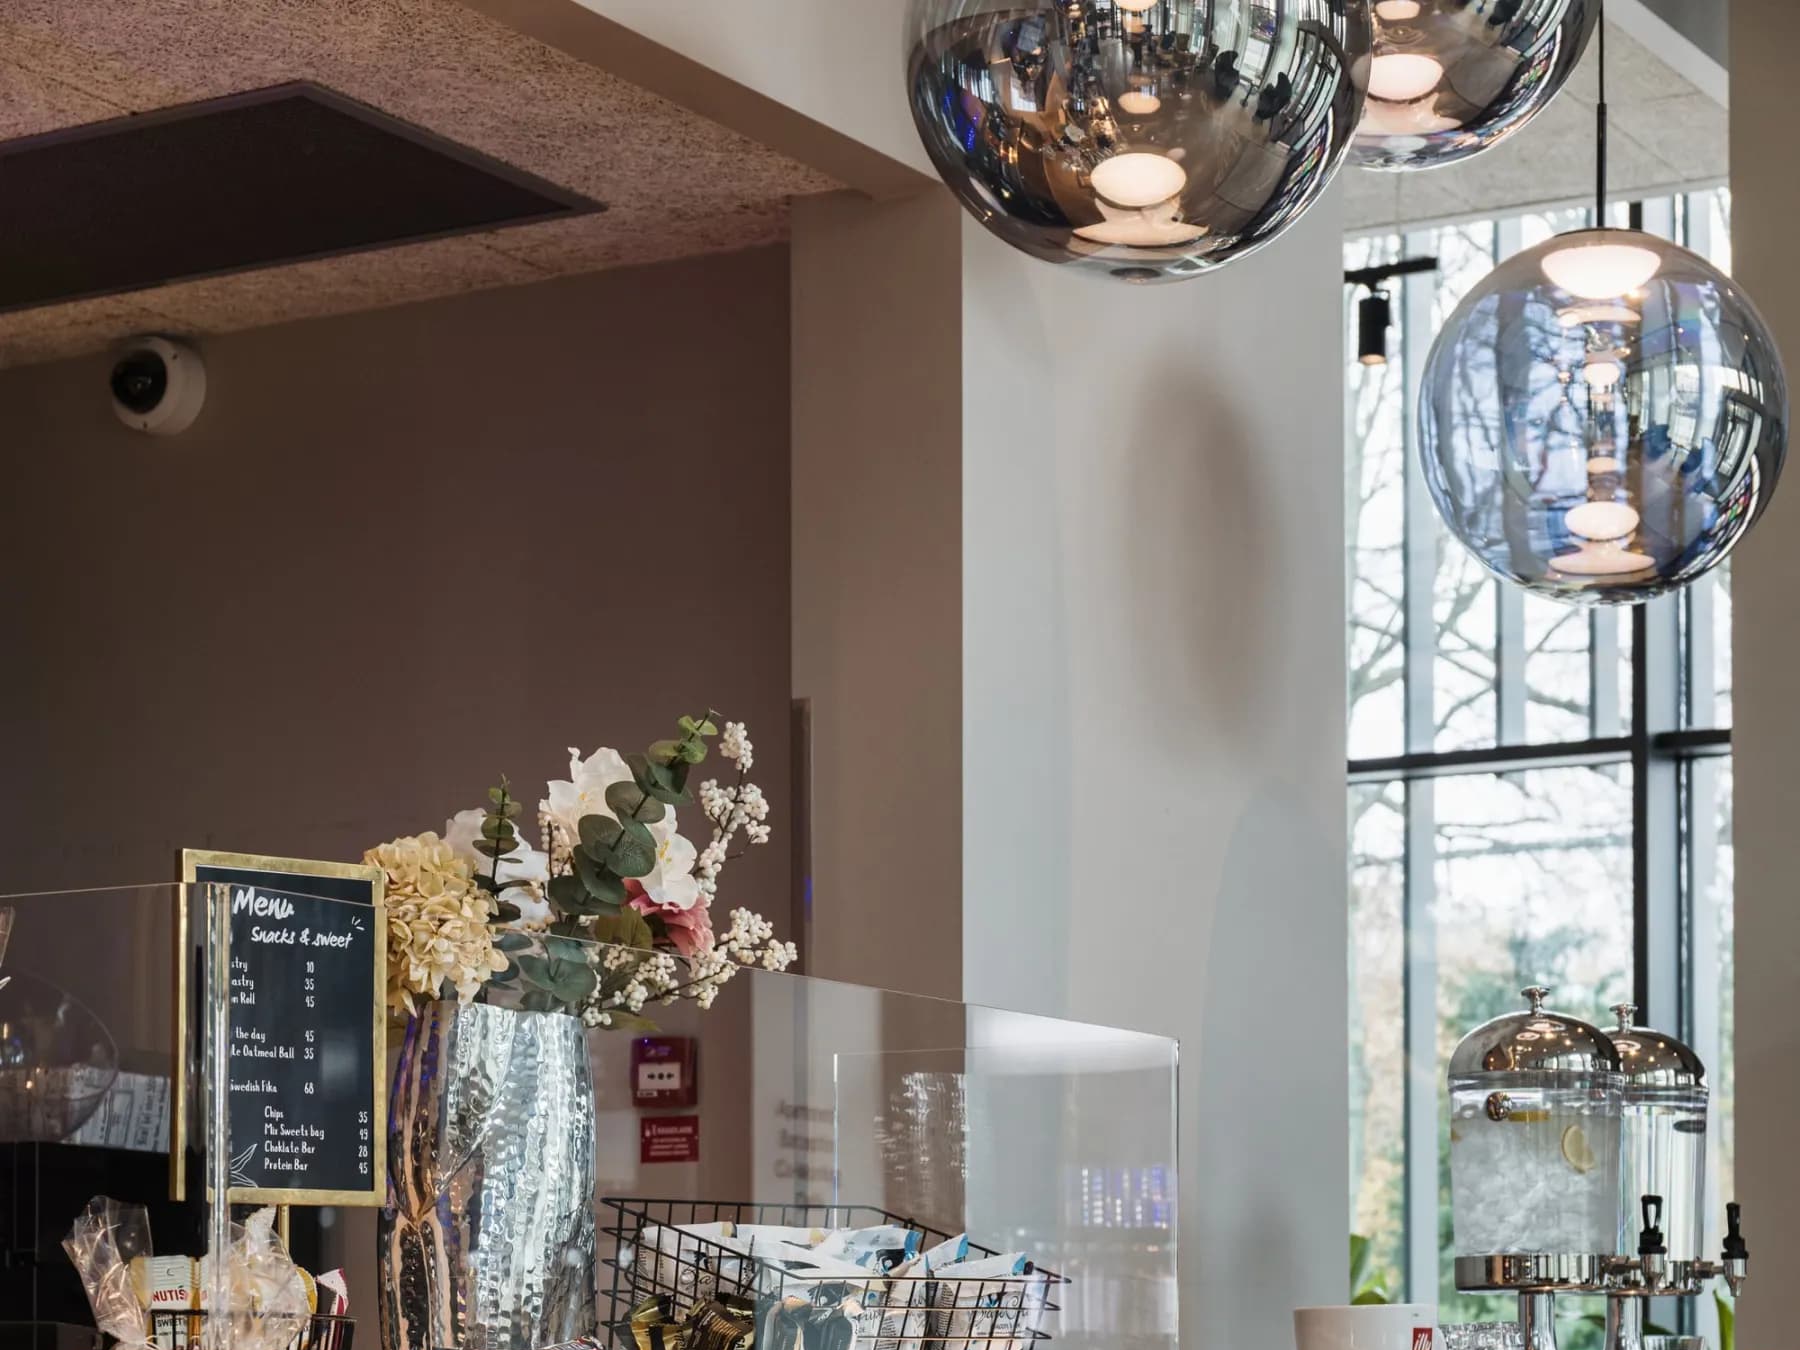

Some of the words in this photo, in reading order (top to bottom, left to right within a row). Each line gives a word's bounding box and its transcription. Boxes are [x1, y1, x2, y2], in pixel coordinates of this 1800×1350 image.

[233, 887, 295, 920] Menu
[251, 926, 296, 945] Snacks
[299, 927, 311, 946] &
[312, 931, 354, 949] sweet
[231, 956, 248, 973] stry
[306, 961, 315, 974] 10
[231, 974, 254, 990] astry
[304, 979, 315, 991] 35
[240, 992, 256, 1005] Roll
[236, 1026, 249, 1039] the
[250, 1027, 266, 1043] day
[304, 1030, 315, 1043] 45
[243, 1044, 278, 1058] Oatmeal
[279, 1046, 295, 1059] Ball
[304, 1047, 315, 1060] 35
[261, 1080, 278, 1093] Fika
[304, 1082, 315, 1095] 68
[264, 1105, 284, 1121] Chips
[358, 1111, 368, 1124] 35
[264, 1123, 278, 1136] Mix
[280, 1124, 309, 1137] Sweets
[310, 1124, 325, 1140] bag
[301, 1141, 316, 1154] Bar
[358, 1145, 369, 1158] 28
[264, 1157, 293, 1171] Protein
[294, 1158, 308, 1171] Bar
[358, 1162, 369, 1175] 45
